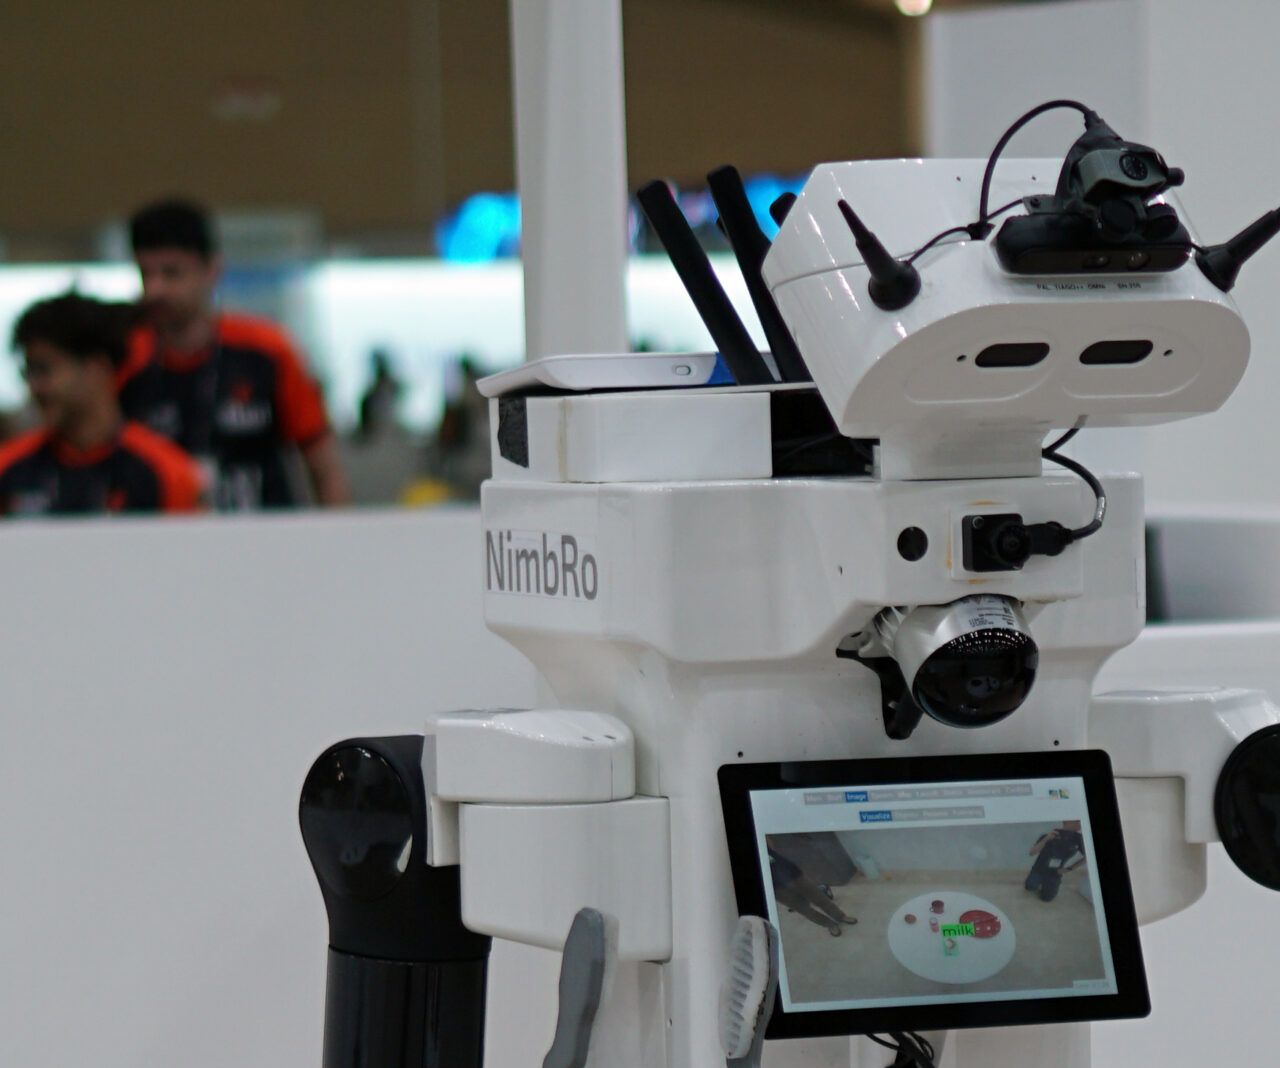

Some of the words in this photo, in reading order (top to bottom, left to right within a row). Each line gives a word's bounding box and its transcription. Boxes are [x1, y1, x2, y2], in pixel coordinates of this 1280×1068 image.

[486, 530, 599, 600] NimbRo
[847, 793, 867, 802] Image
[861, 811, 891, 821] Visualize
[943, 924, 974, 937] milk
